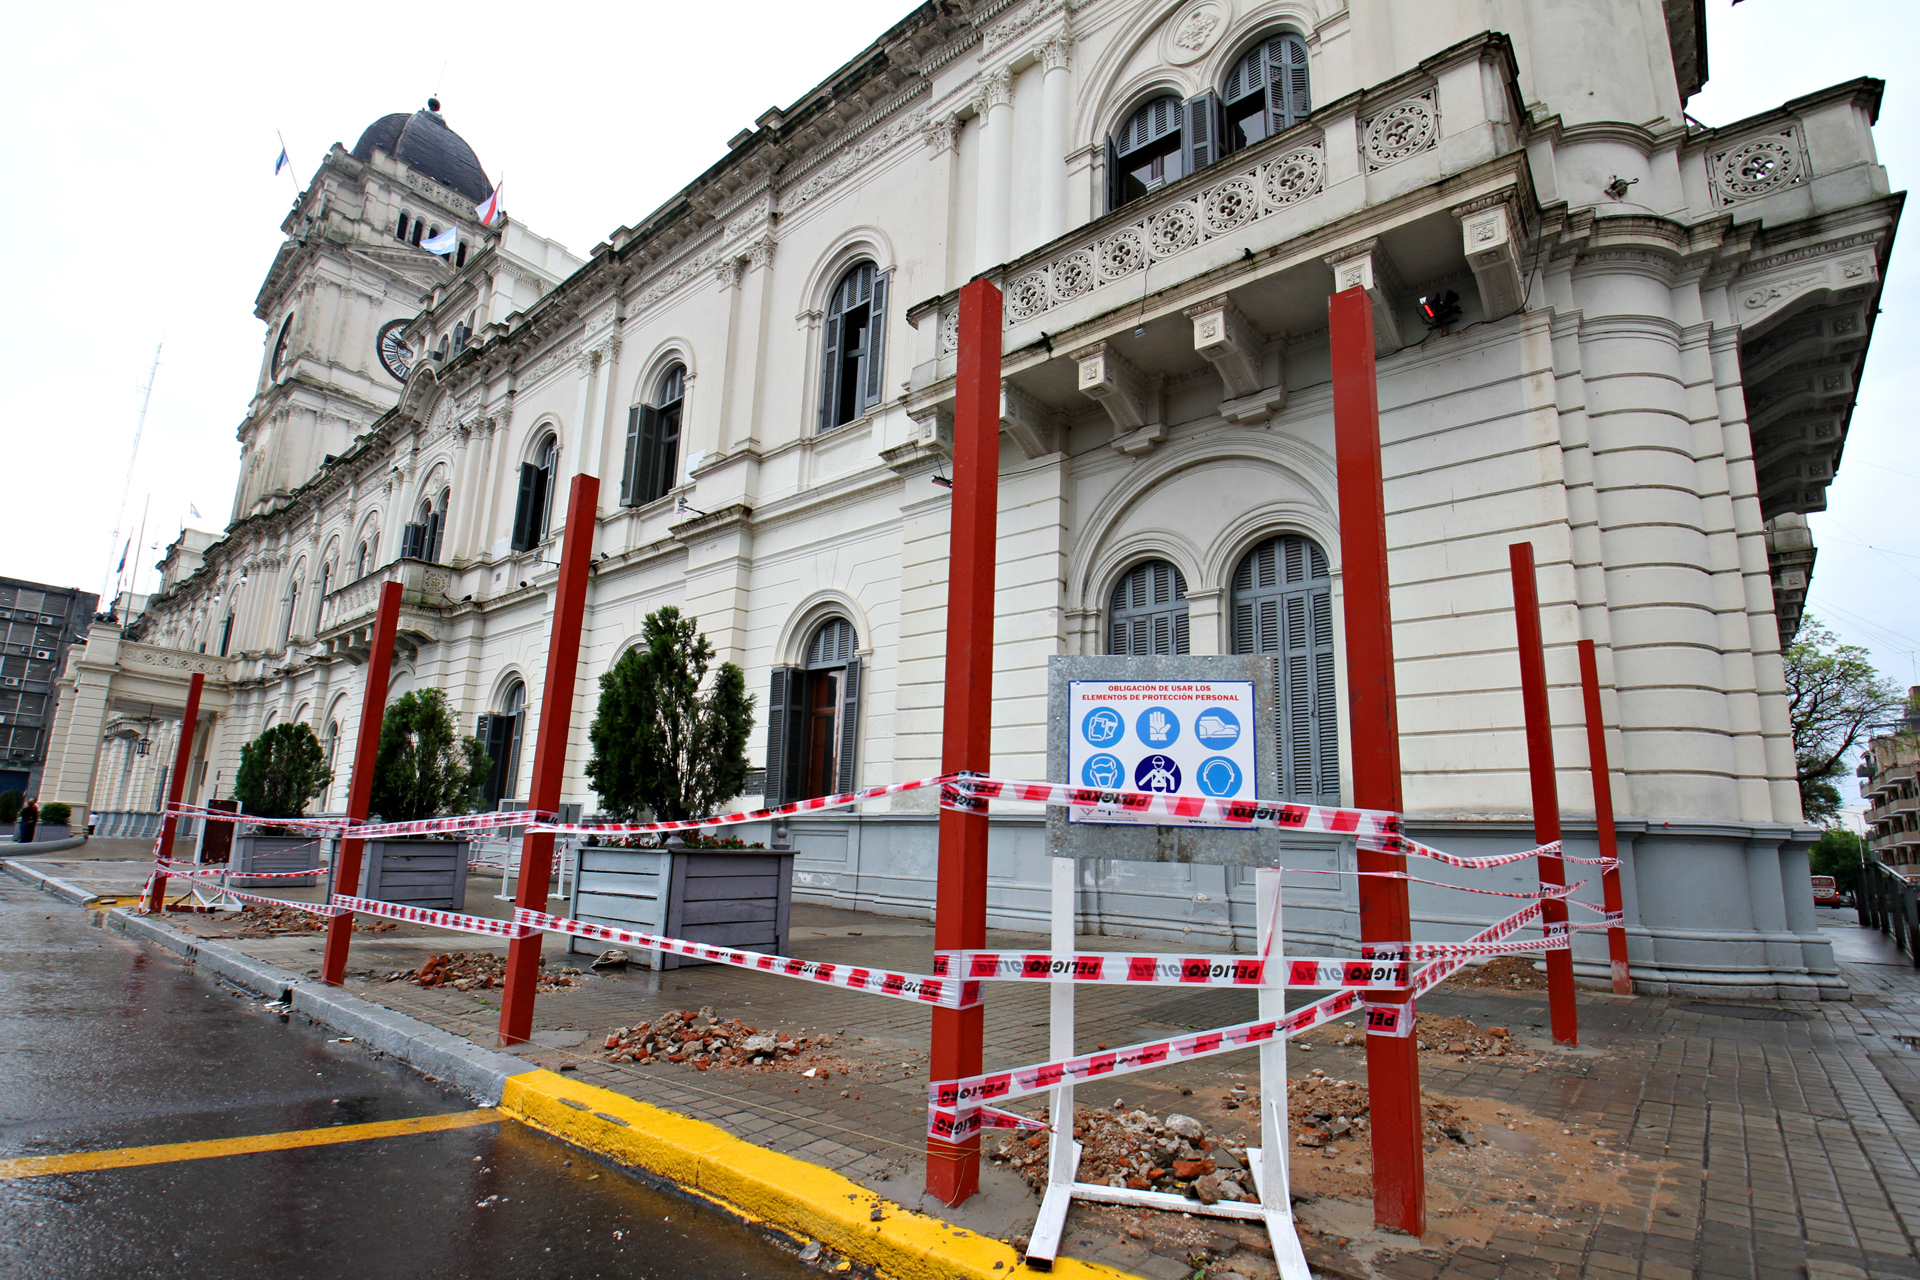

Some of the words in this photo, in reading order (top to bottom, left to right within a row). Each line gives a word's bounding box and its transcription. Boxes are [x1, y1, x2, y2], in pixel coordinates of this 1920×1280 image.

[1108, 684, 1156, 692] OBLIGACIÓN
[1142, 692, 1193, 701] PROTECCIÓN
[1029, 960, 1099, 975] PELIGRO
[1188, 964, 1260, 979] PELIGRO
